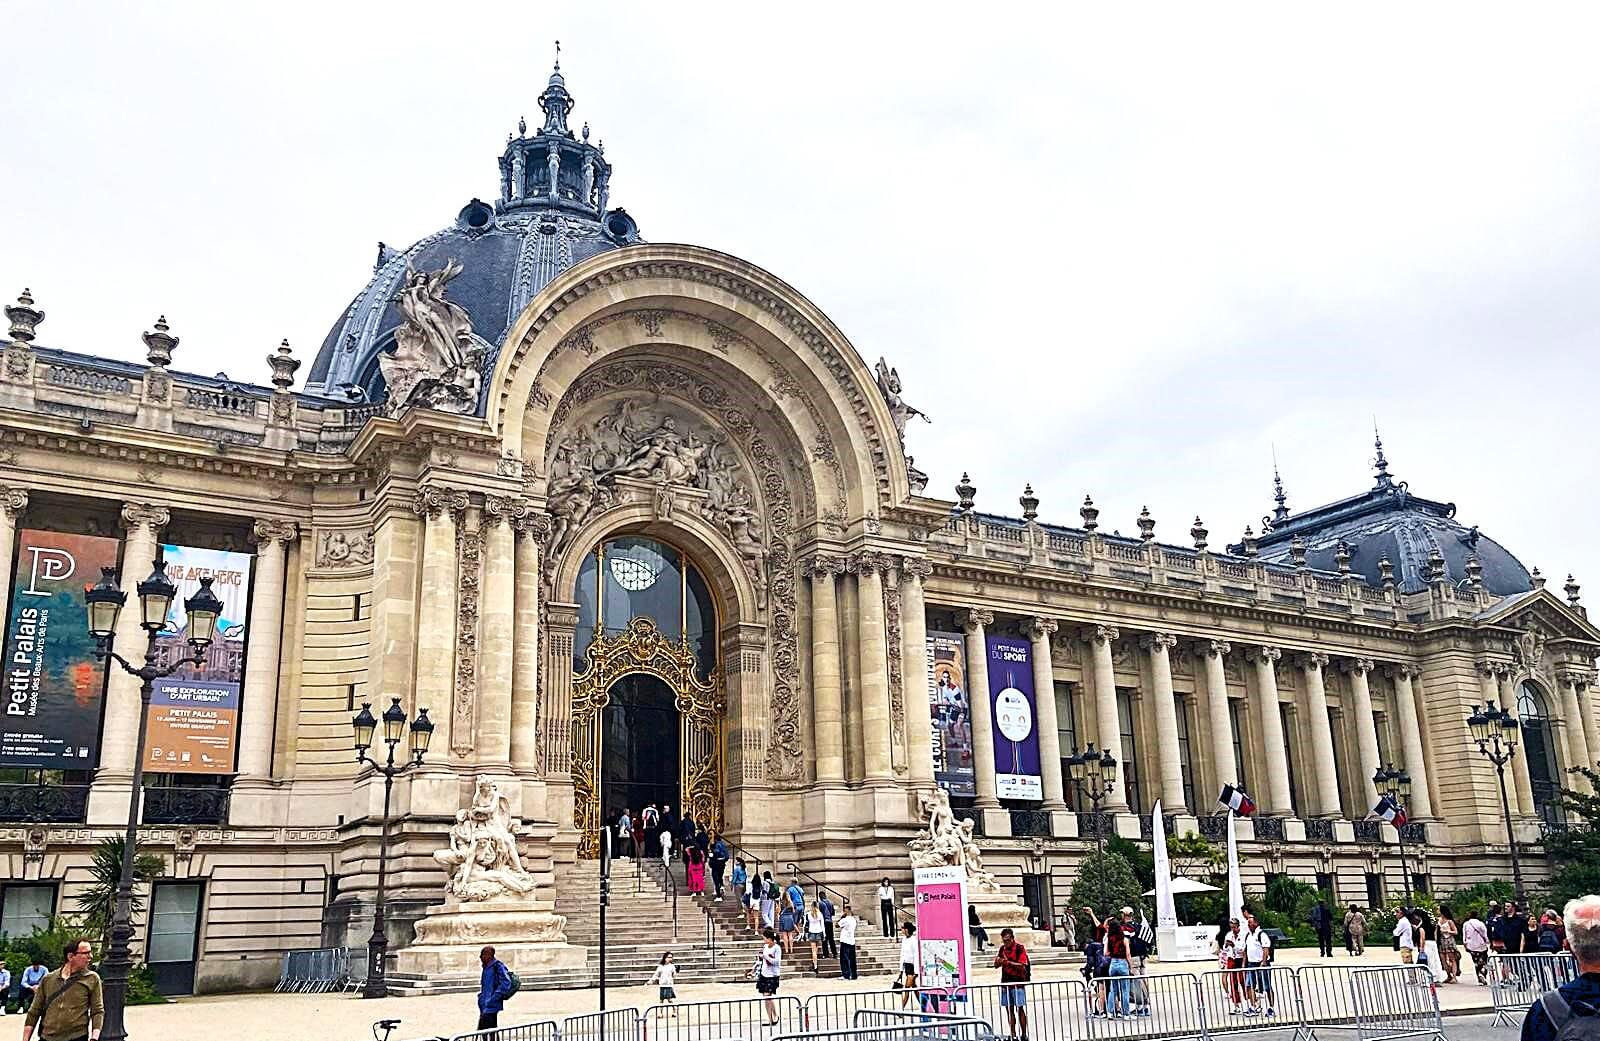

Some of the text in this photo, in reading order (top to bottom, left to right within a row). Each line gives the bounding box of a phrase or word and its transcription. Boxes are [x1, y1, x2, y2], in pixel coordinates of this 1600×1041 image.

[7, 608, 38, 716] Petit Palais
[28, 609, 48, 716] Musée des Beaux-Arts de Paris
[1004, 652, 1026, 662] SPORT
[180, 688, 229, 697] EXPLORATION
